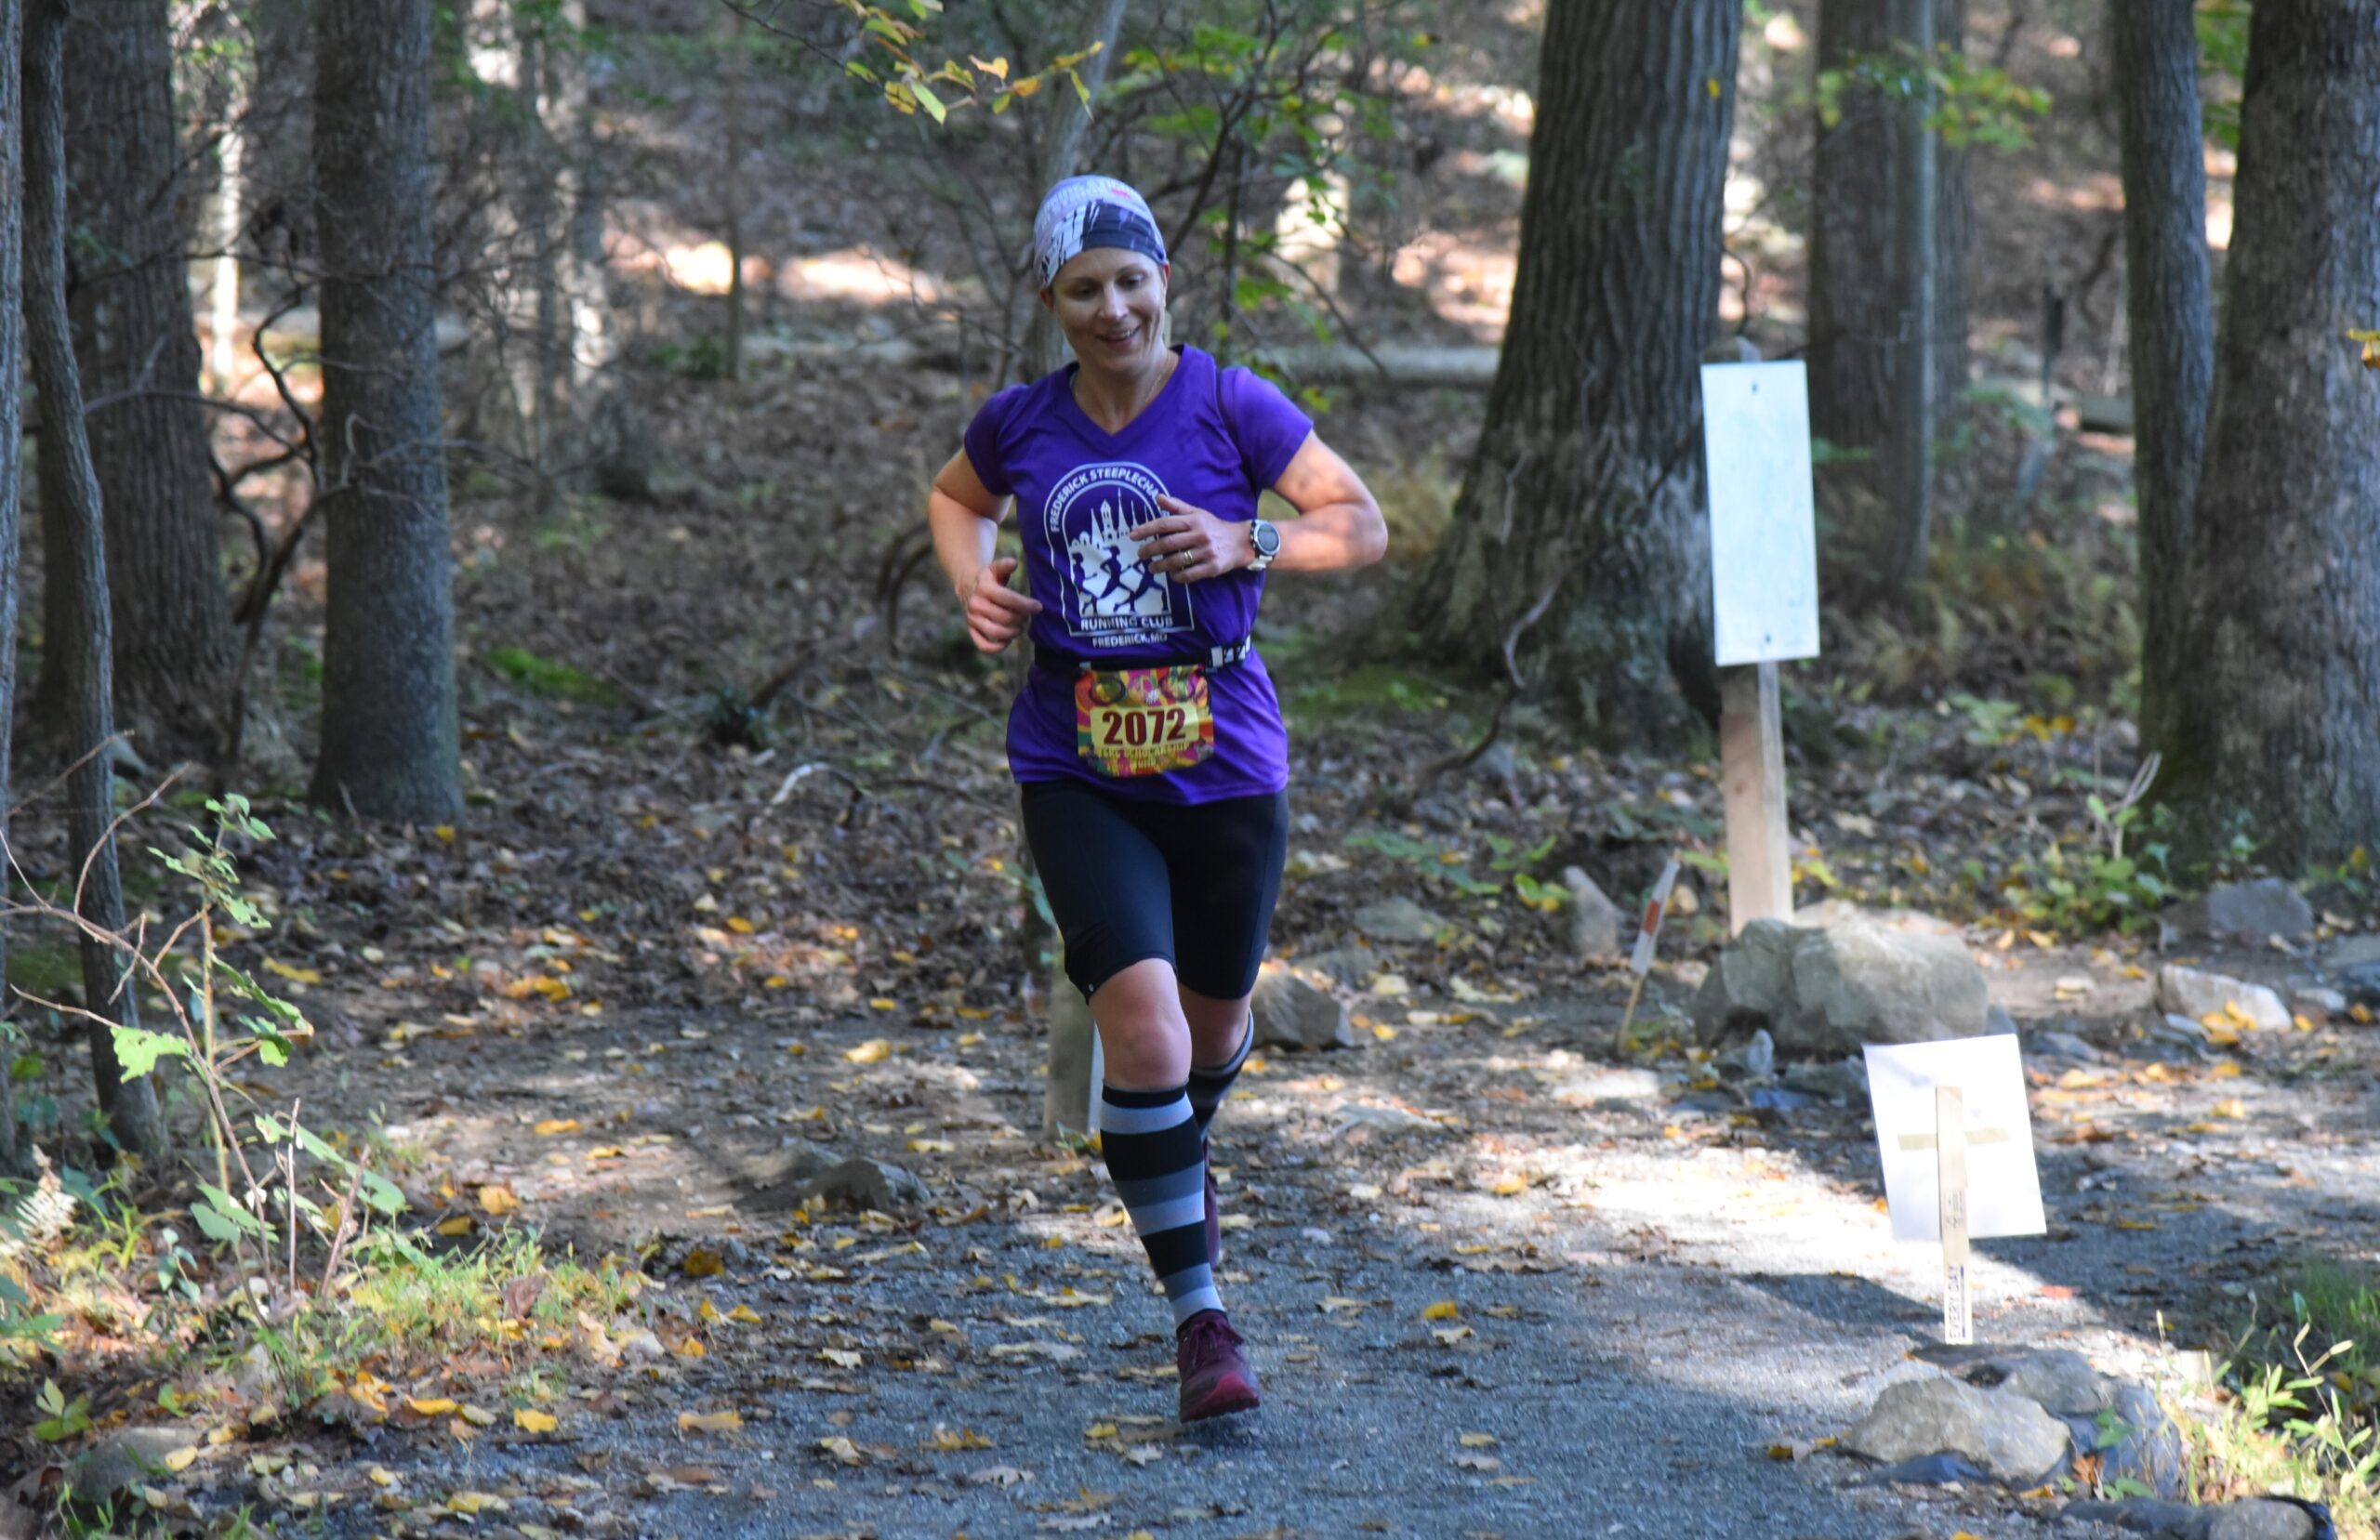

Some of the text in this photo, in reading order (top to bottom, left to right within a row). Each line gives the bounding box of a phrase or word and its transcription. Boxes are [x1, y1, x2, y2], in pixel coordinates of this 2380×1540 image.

[1050, 475, 1089, 533] FREDERICK
[1080, 615, 1173, 631] RUNNING CLUB
[1102, 708, 1186, 746] 2072
